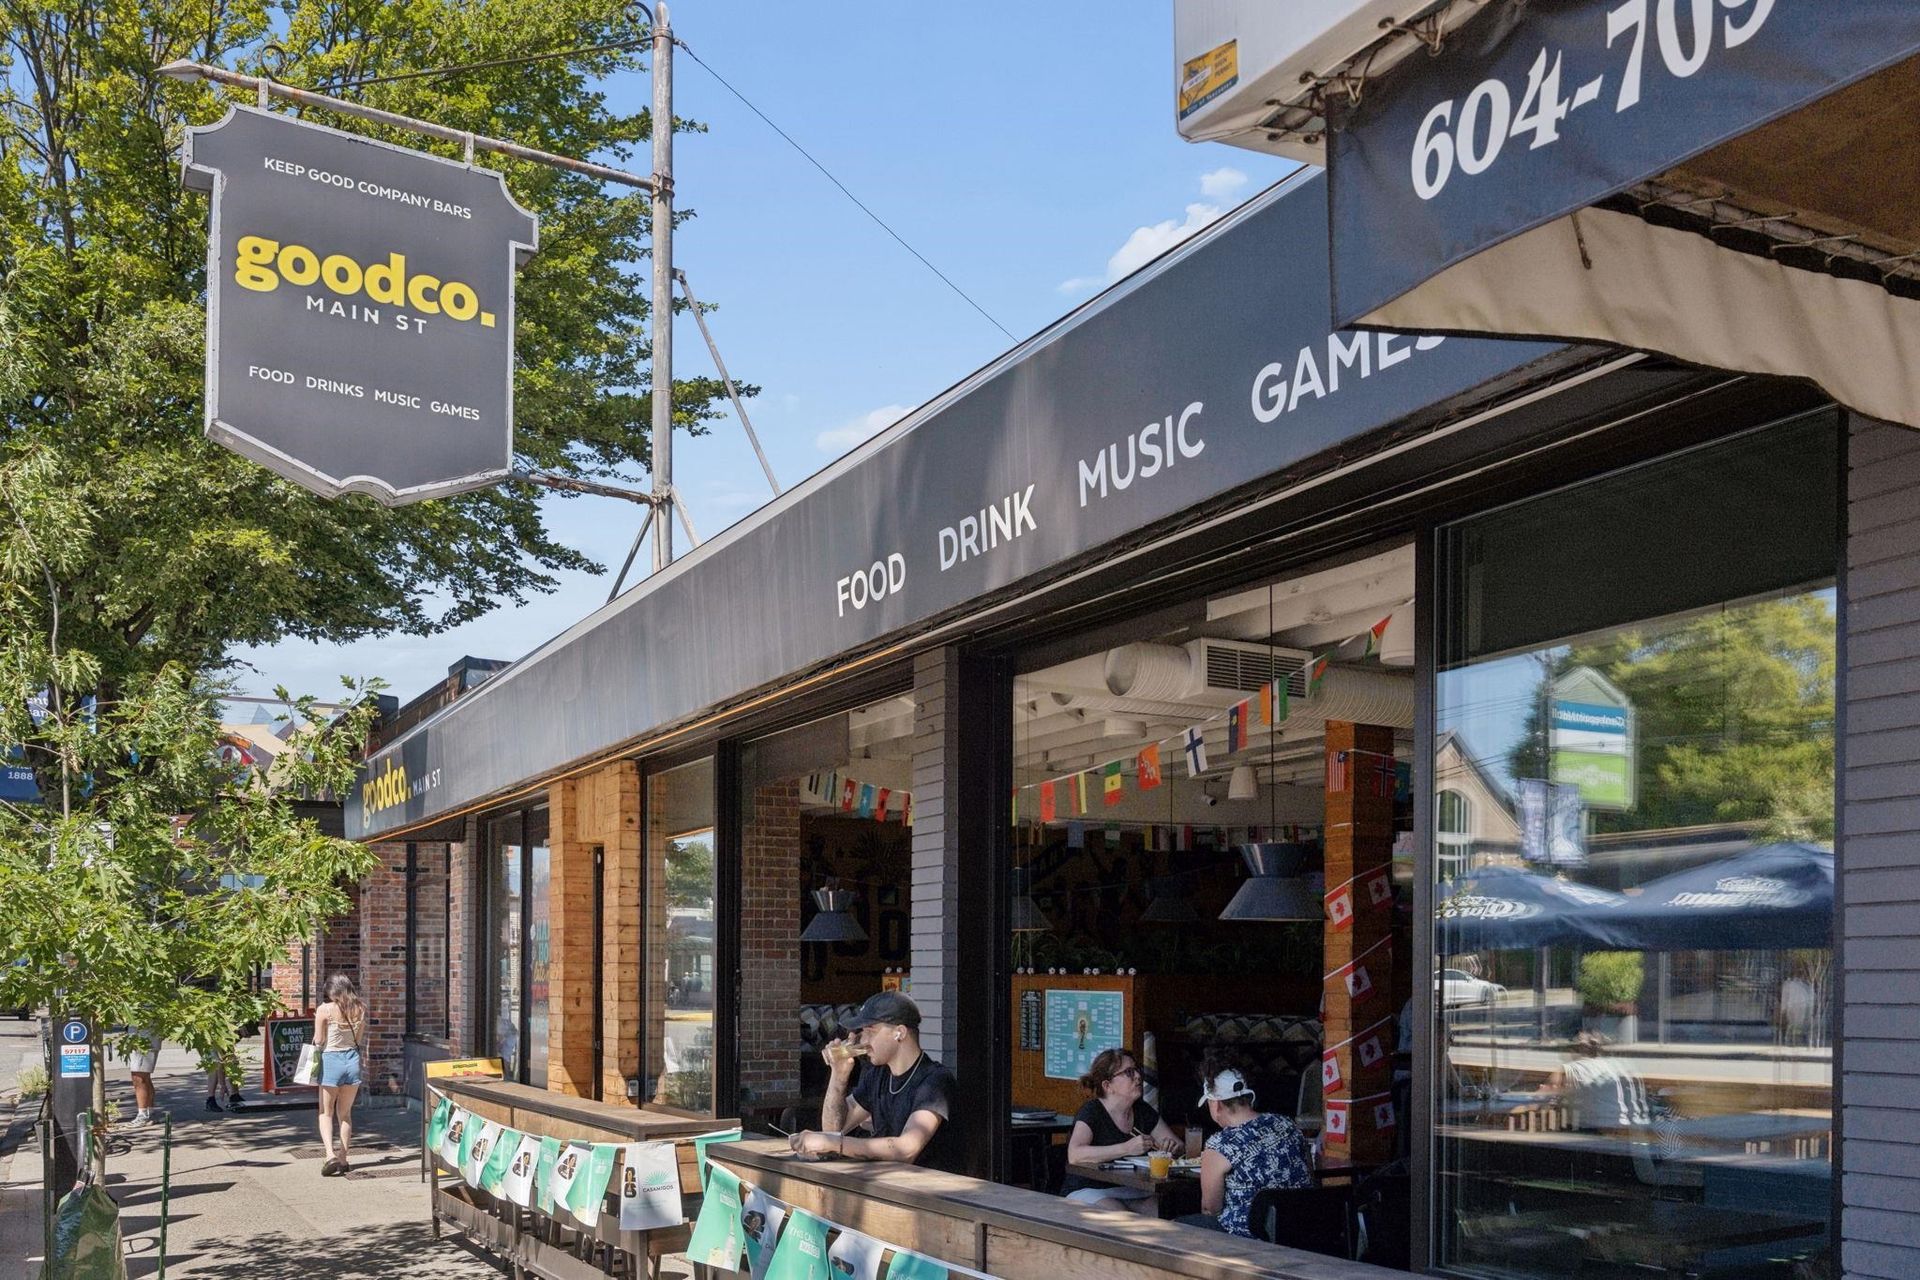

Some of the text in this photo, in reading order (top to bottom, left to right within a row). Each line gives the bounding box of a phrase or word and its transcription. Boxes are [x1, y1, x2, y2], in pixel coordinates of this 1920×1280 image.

[264, 156, 472, 220] KEEP GOOD COMPANY BARS
[234, 235, 495, 327] goodco.
[306, 295, 428, 334] MAIN ST
[248, 365, 481, 421] FOOD DRINKS MUSIC GAMES
[836, 552, 906, 618] FOOD
[938, 483, 1038, 572] DRINK
[1078, 401, 1206, 508] MUSIC
[8, 771, 33, 781] 1888
[363, 758, 441, 828] goodco. MAIN ST
[70, 1026, 81, 1040] P
[282, 1028, 304, 1036] GAME
[289, 1035, 304, 1043] DAY
[642, 1184, 675, 1193] CASAMIGOS
